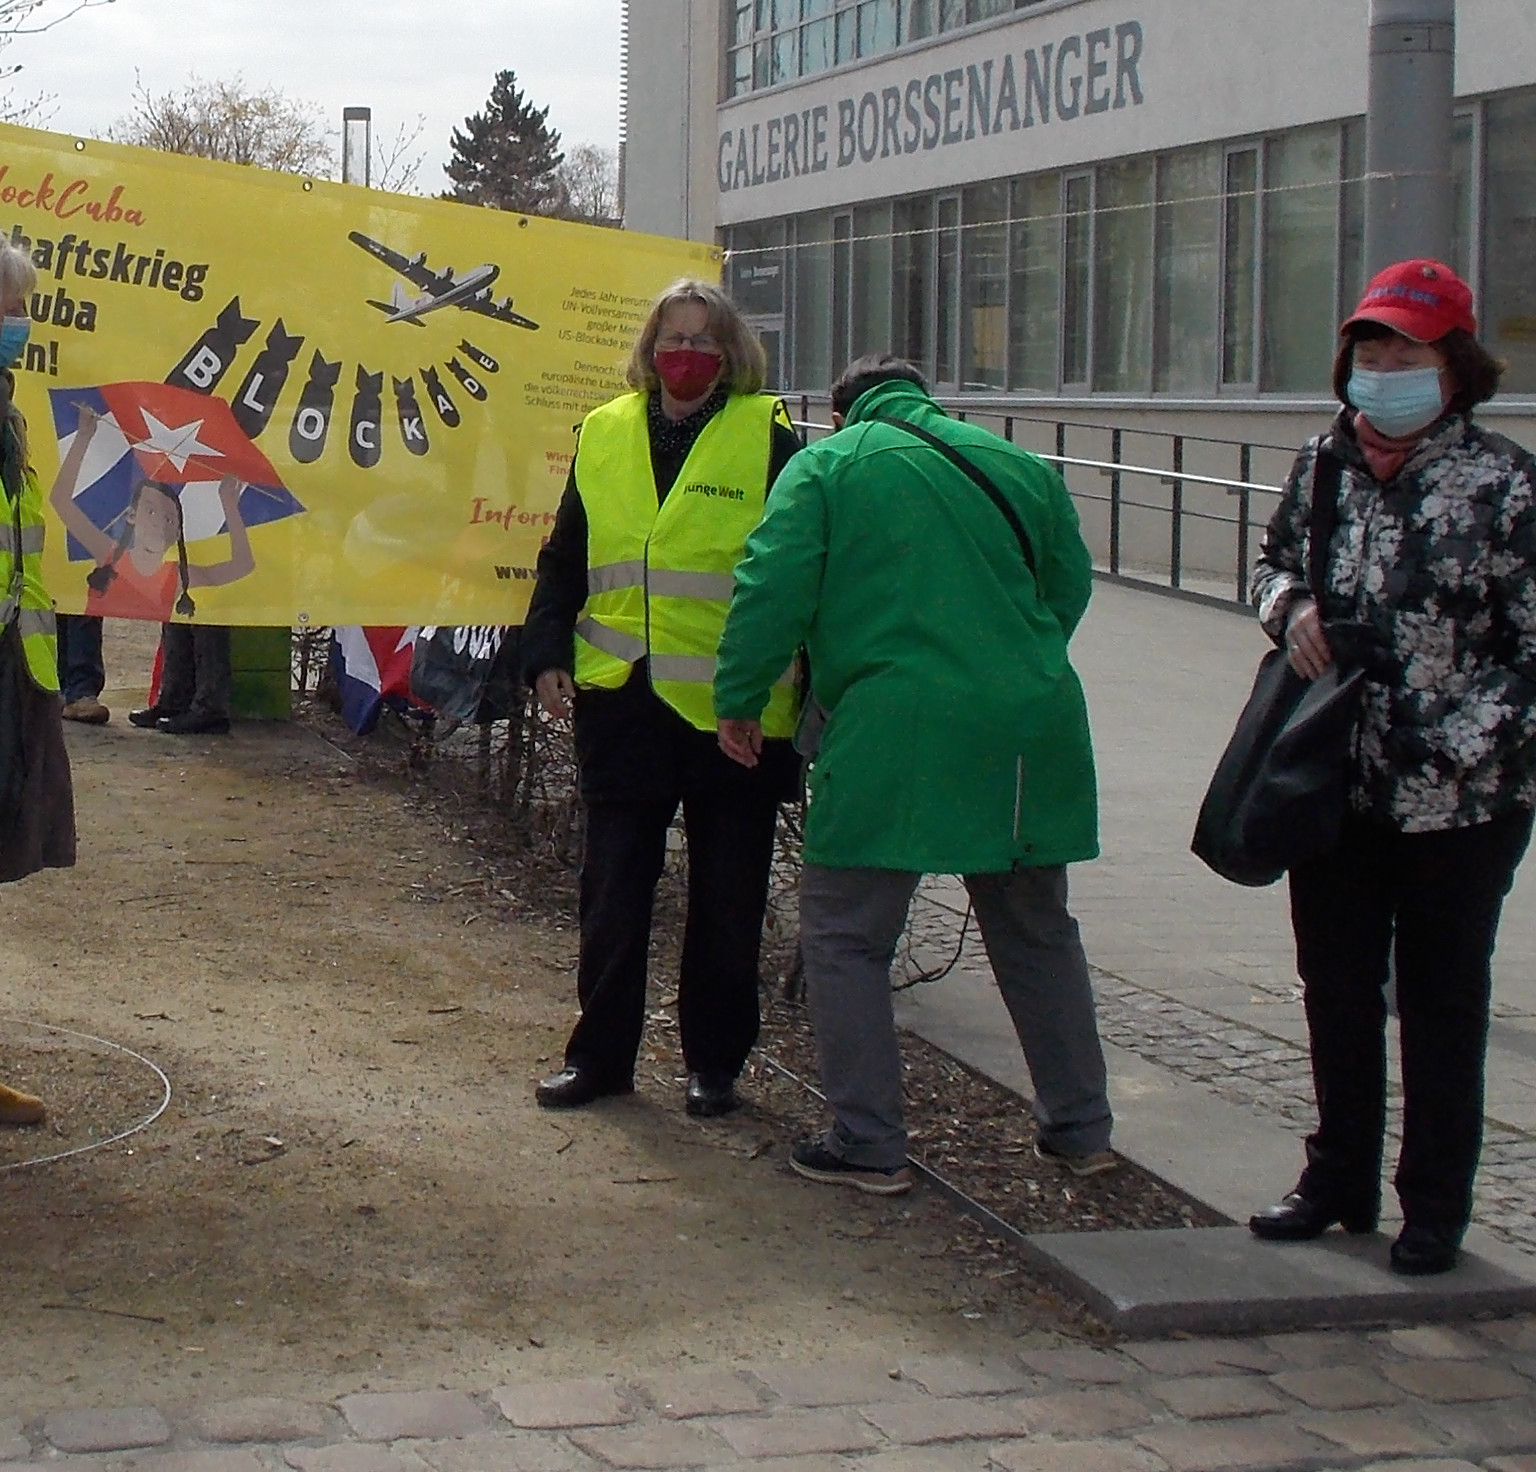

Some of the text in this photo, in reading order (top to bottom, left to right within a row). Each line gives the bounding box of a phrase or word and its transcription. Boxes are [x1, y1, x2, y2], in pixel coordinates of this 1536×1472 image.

[717, 20, 1145, 193] GALERIE BORSSENANGER
[570, 286, 597, 300] Jedes
[599, 291, 618, 304] Jahr
[23, 287, 98, 333] uba
[558, 329, 618, 348] US-Blockade
[574, 360, 615, 376] Dennoch
[524, 382, 539, 392] die
[541, 371, 598, 387] europäische
[524, 395, 560, 410] Schluss
[563, 401, 579, 412] mit
